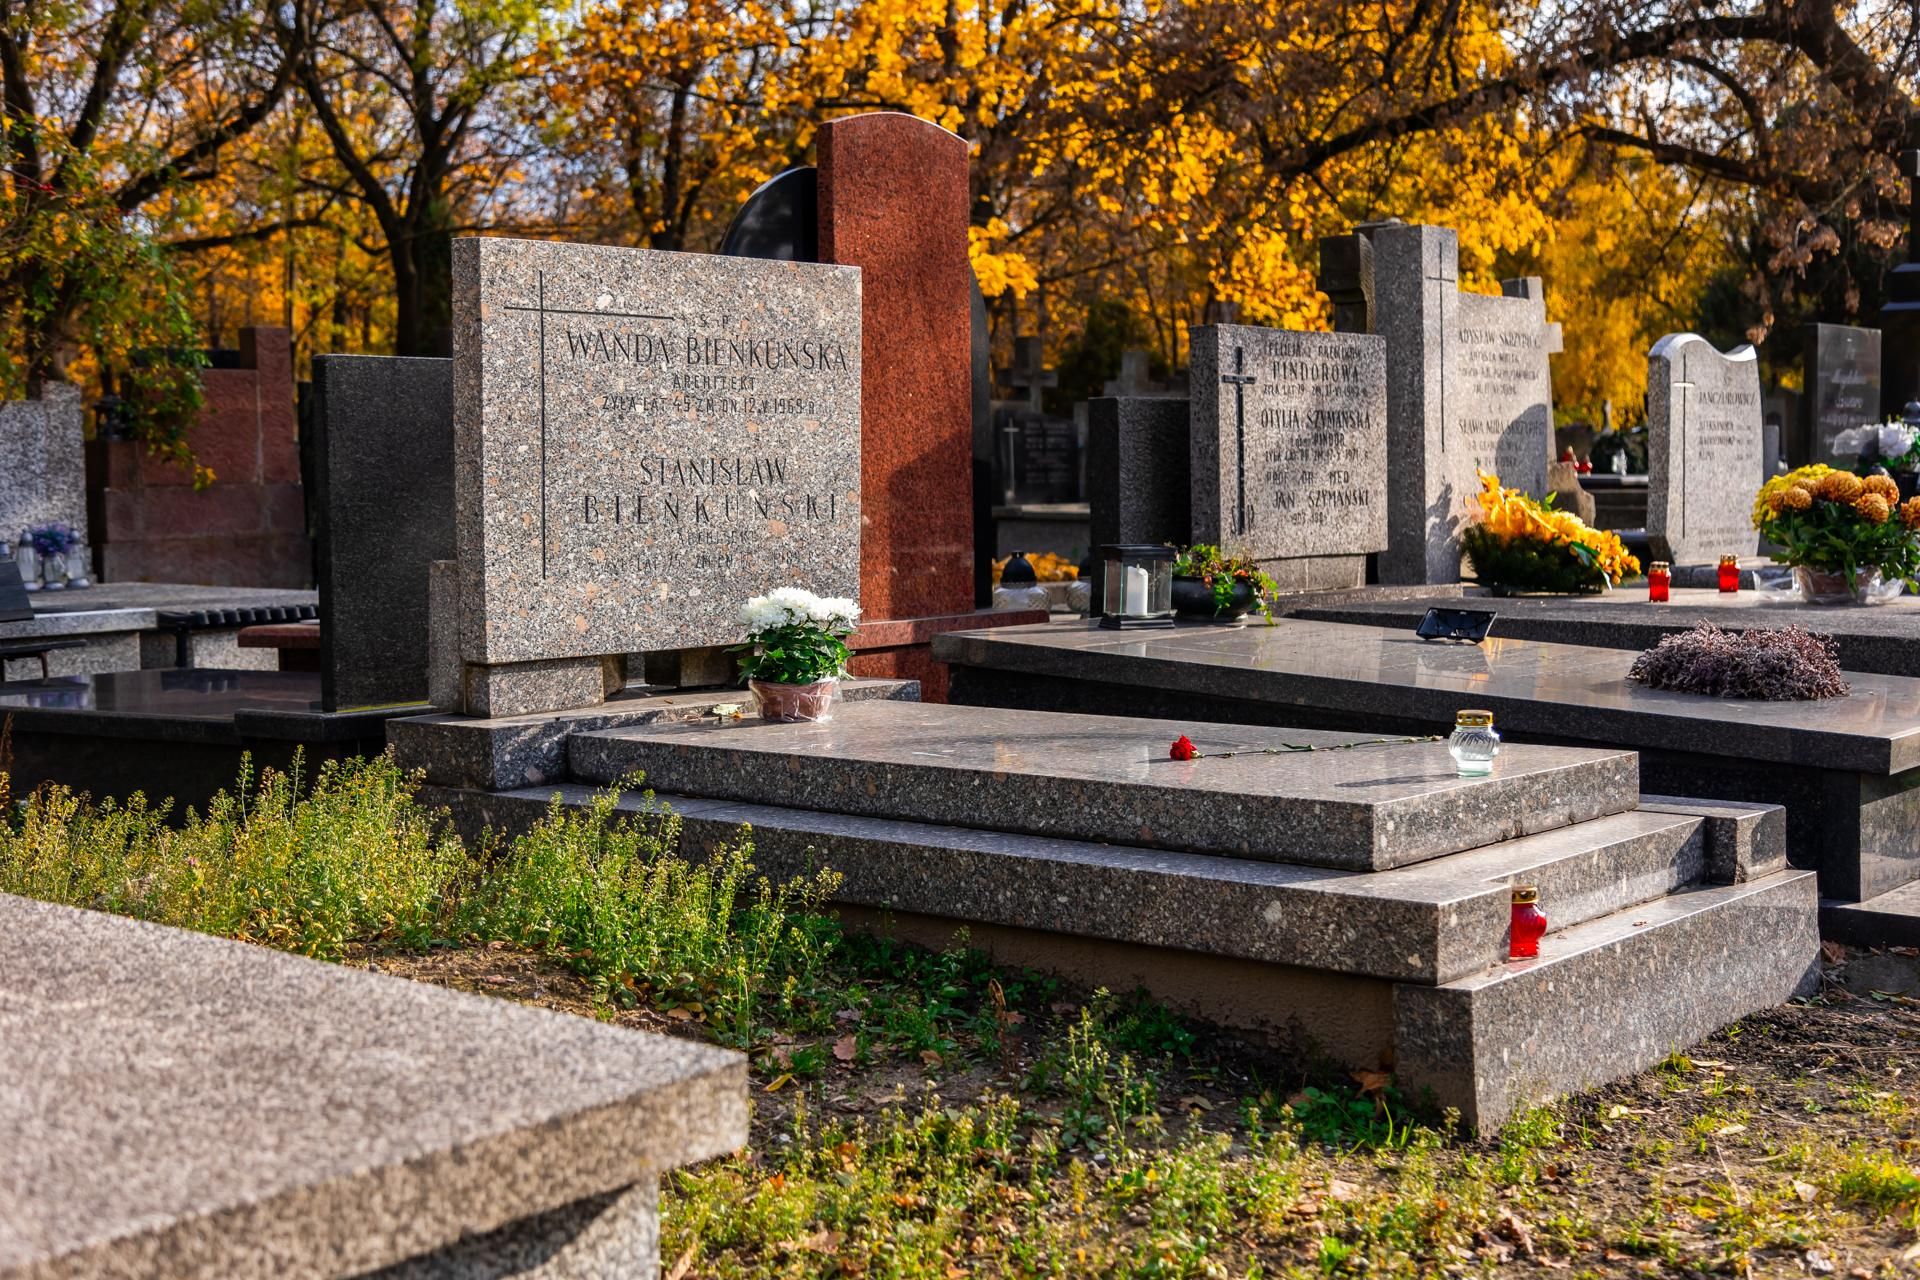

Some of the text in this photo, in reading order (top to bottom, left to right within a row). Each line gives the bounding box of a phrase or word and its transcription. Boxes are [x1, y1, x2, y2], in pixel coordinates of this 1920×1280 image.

[566, 330, 671, 364] WANDA
[1273, 361, 1359, 383] PINDOROWA
[1261, 408, 1300, 429] OTYLIA
[641, 457, 788, 487] STANISŁAW
[1272, 490, 1295, 511] JAN
